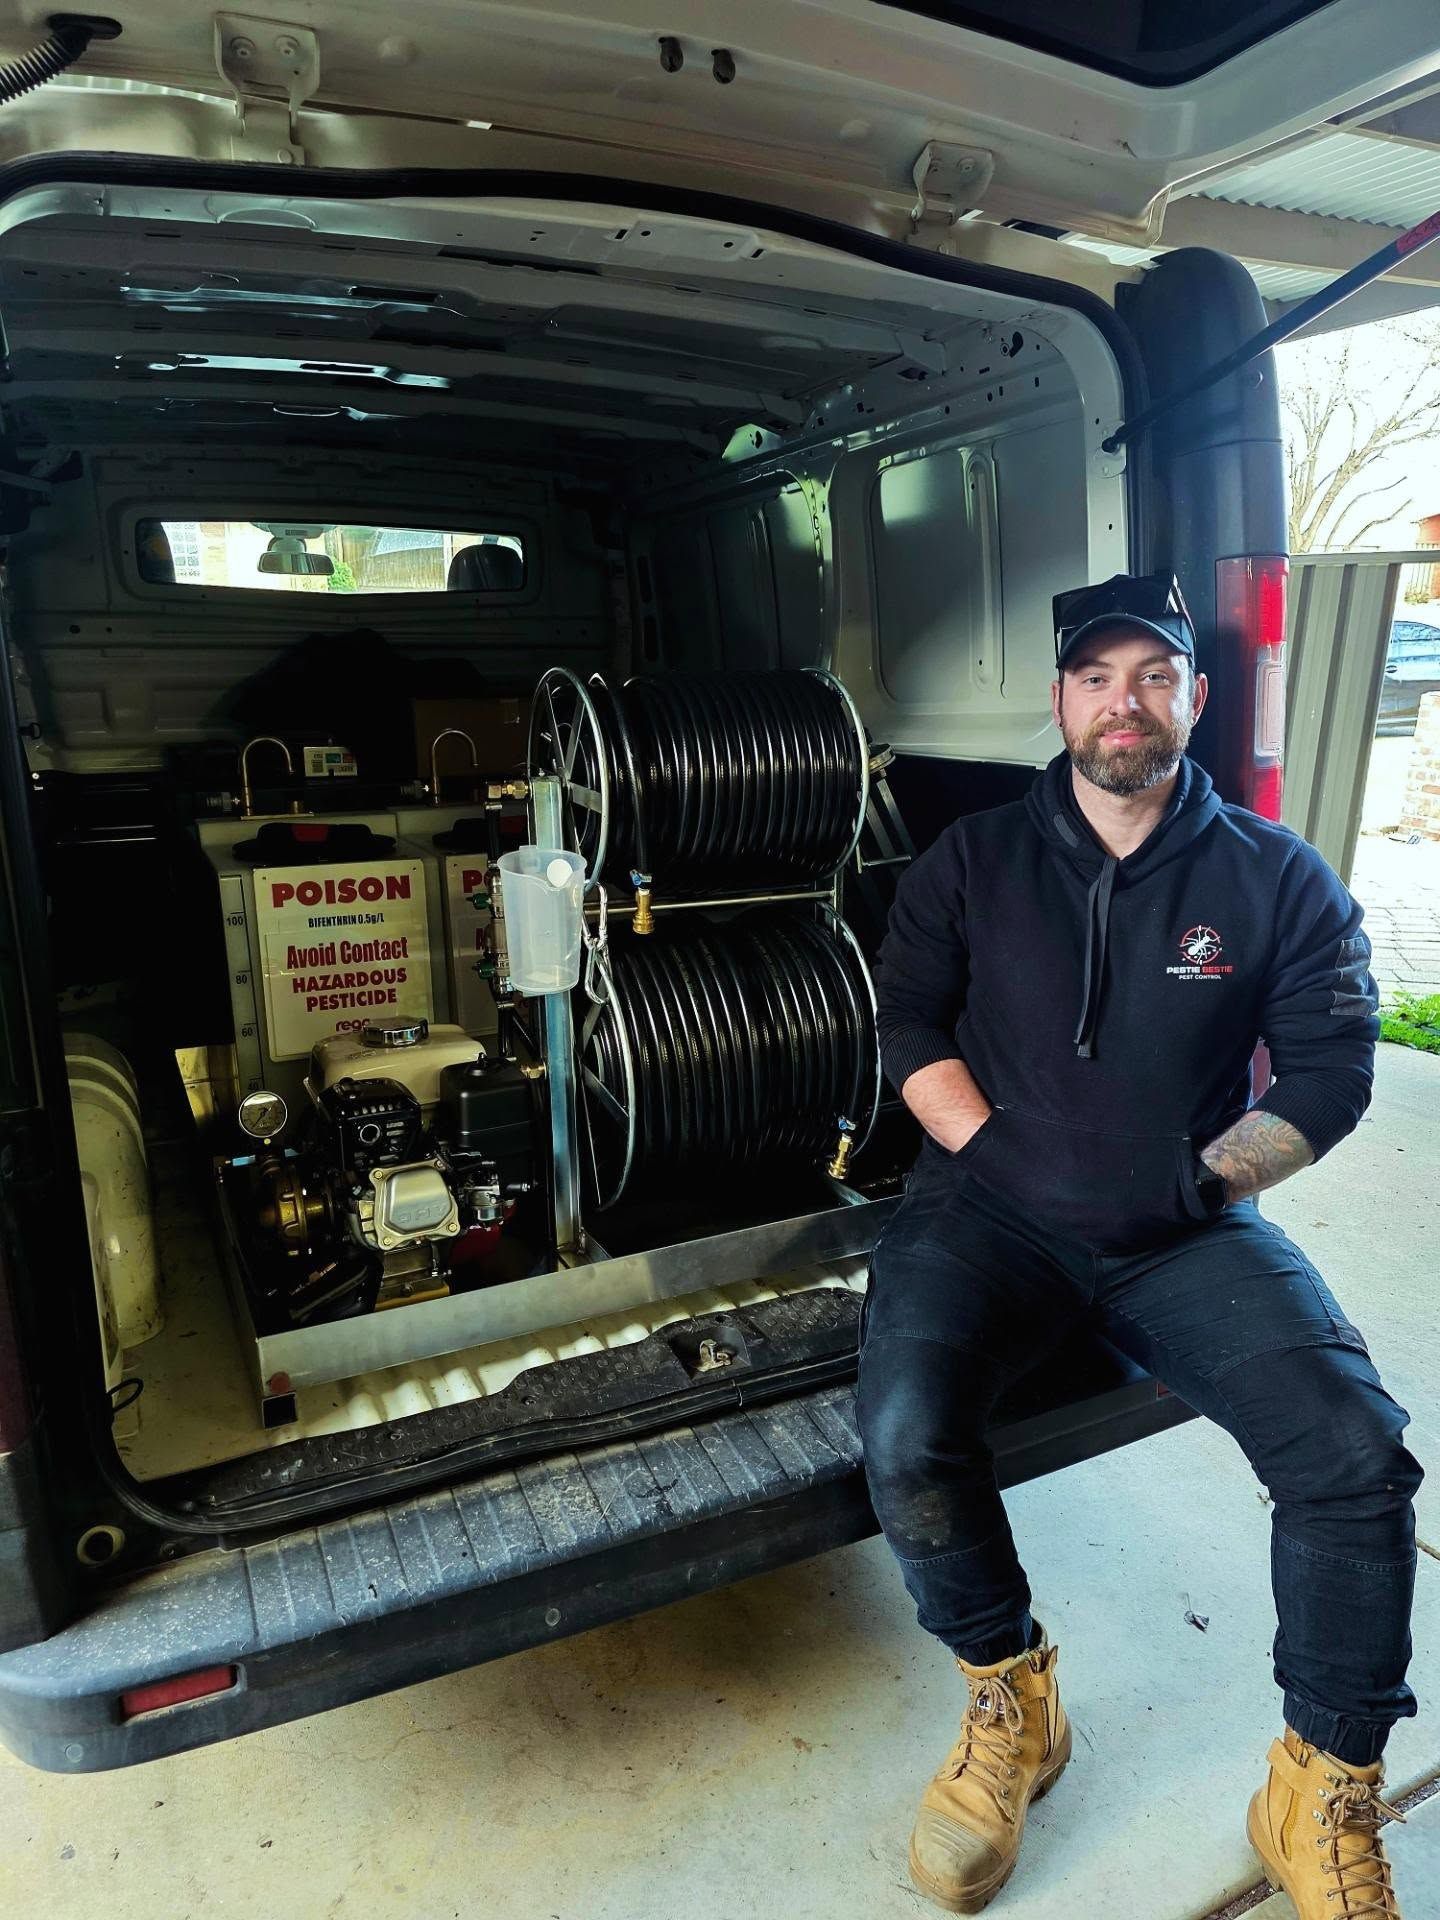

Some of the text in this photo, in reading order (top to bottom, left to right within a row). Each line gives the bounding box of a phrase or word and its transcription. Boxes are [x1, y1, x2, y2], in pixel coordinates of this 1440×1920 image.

[271, 875, 411, 908] POISON
[226, 916, 244, 926] 100
[308, 912, 384, 928] BIFENTHRIN 0.5g/L
[287, 937, 408, 969] Avoid Contact
[235, 974, 248, 985] 80
[292, 967, 407, 993] HAZARDOUS
[306, 988, 397, 1012] PESTICIDE
[241, 1027, 253, 1037] 60
